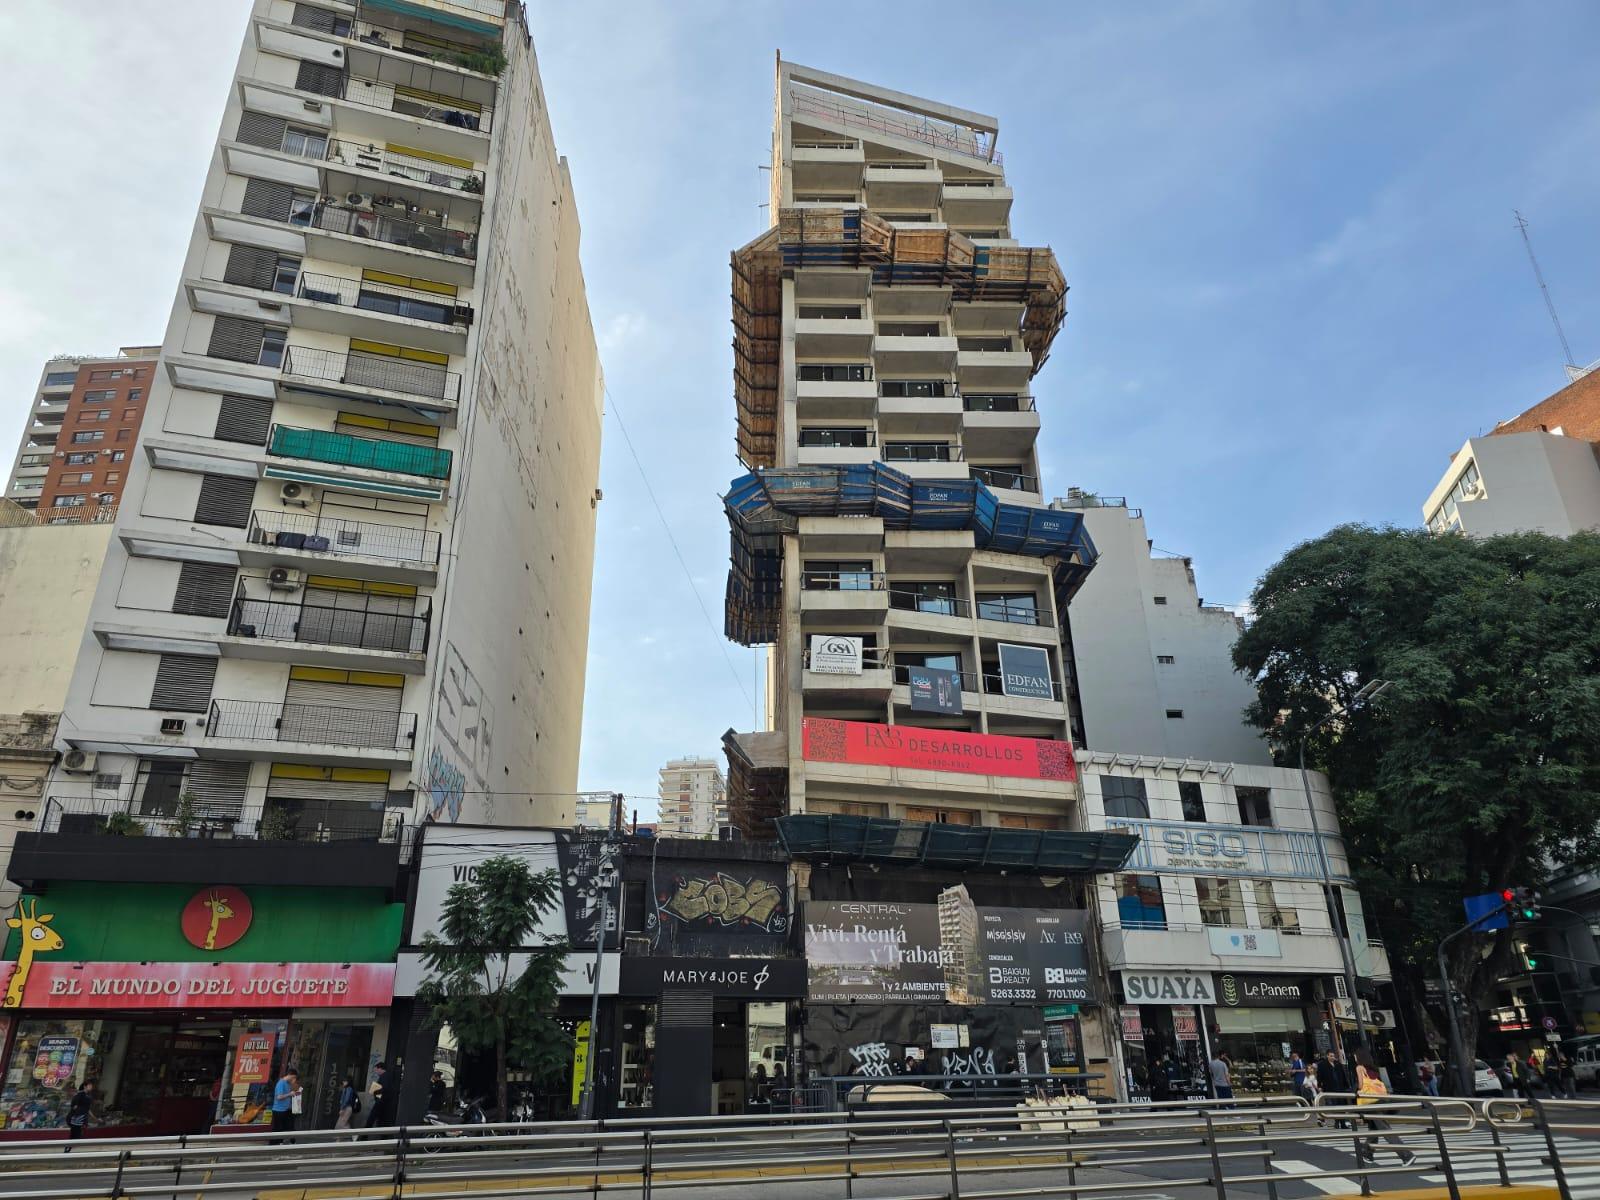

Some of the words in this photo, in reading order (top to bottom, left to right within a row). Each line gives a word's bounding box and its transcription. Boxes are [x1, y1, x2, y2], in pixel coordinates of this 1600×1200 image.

[827, 643, 851, 654] GSA
[1007, 674, 1048, 688] EDFAN
[909, 738, 1024, 761] DESARROLLOS
[1163, 830, 1247, 857] SISO
[840, 903, 907, 914] CENTRAL
[853, 924, 907, 943] Rentá
[883, 944, 954, 968] Trabajá
[49, 978, 82, 995] EL
[90, 979, 180, 995] MUNDO
[188, 979, 235, 995] DEL
[241, 978, 348, 995] JUGUETE
[1003, 976, 1030, 984] REALTY
[1127, 976, 1210, 999] SUAYA
[990, 988, 1036, 999] 5263.3332
[1244, 982, 1259, 996] Le
[1260, 982, 1300, 997] Panem
[256, 1040, 269, 1050] SALE
[239, 1058, 259, 1073] 70%
